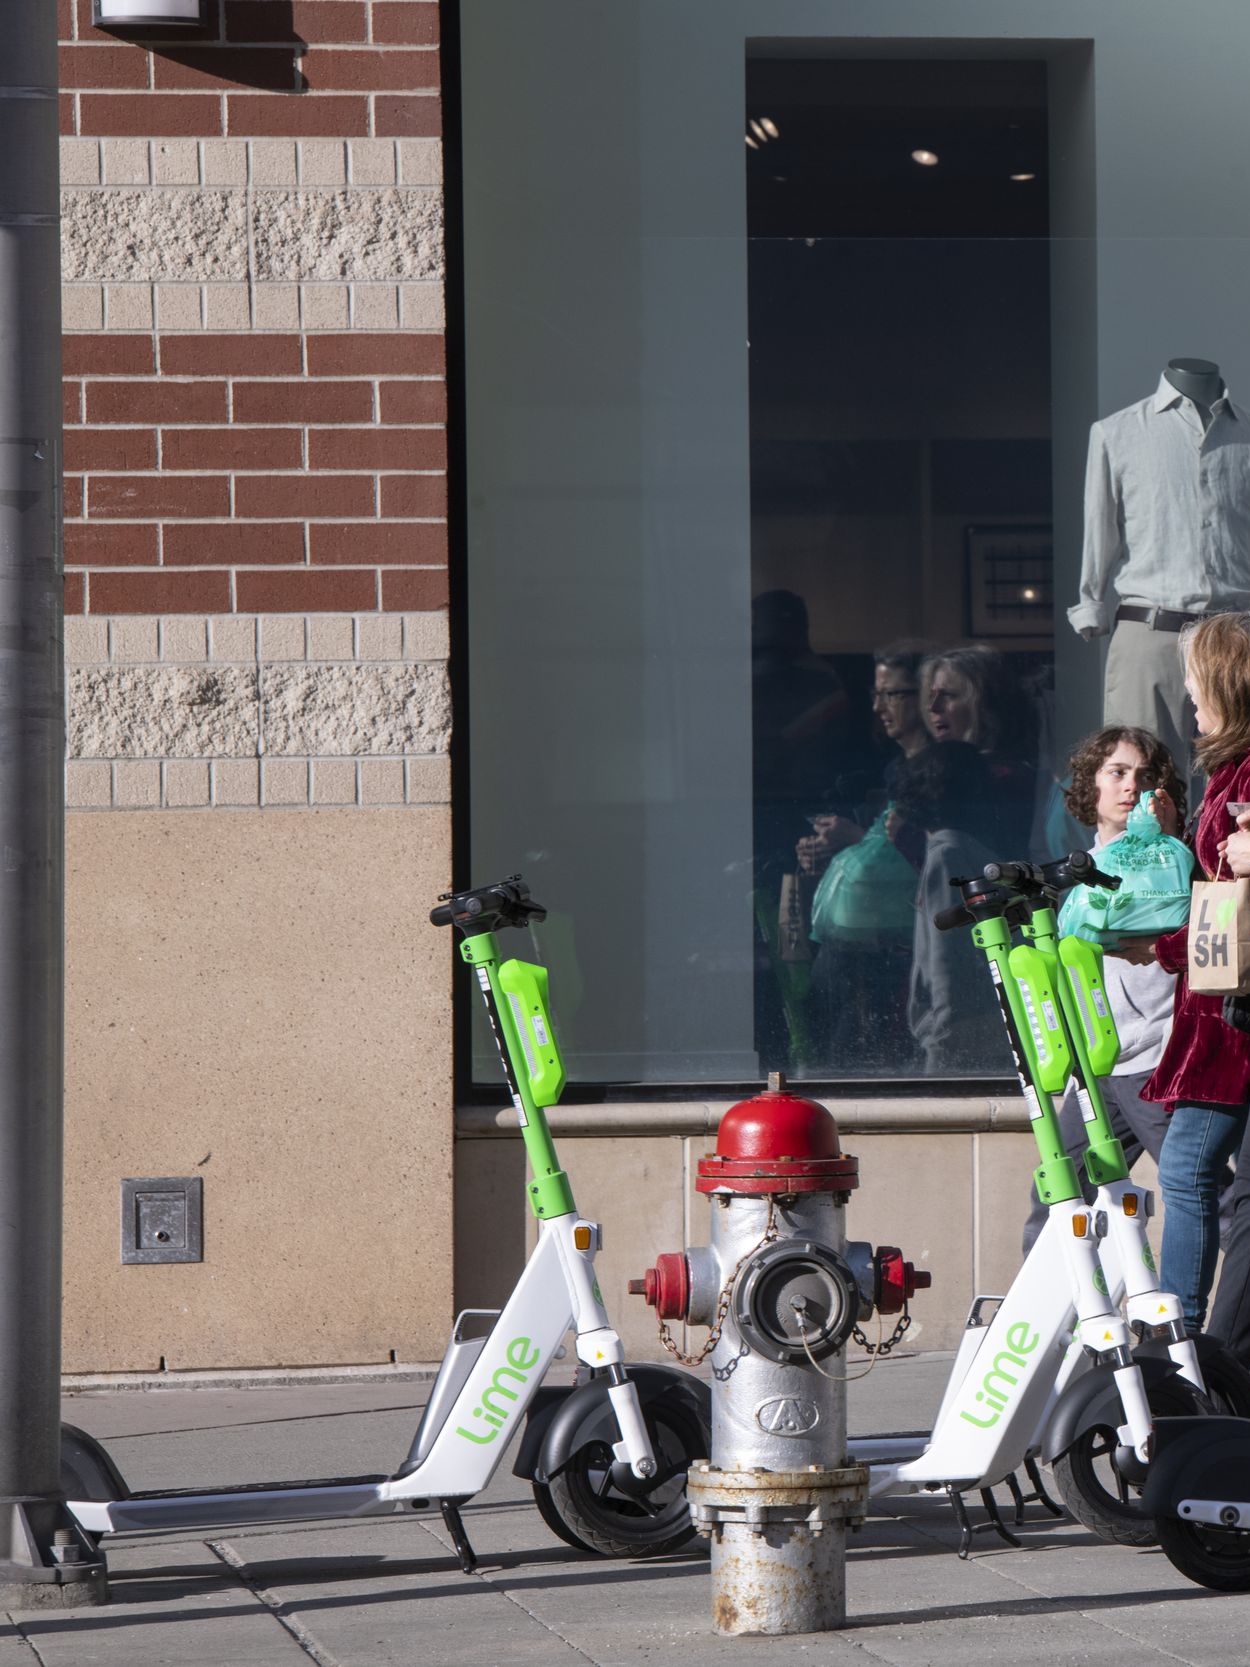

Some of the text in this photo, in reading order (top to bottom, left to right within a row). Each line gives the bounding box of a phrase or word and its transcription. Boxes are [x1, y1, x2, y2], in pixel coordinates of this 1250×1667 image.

[1141, 889, 1169, 898] THANK
[456, 1337, 541, 1446] Lime
[960, 1321, 1040, 1429] Lime
